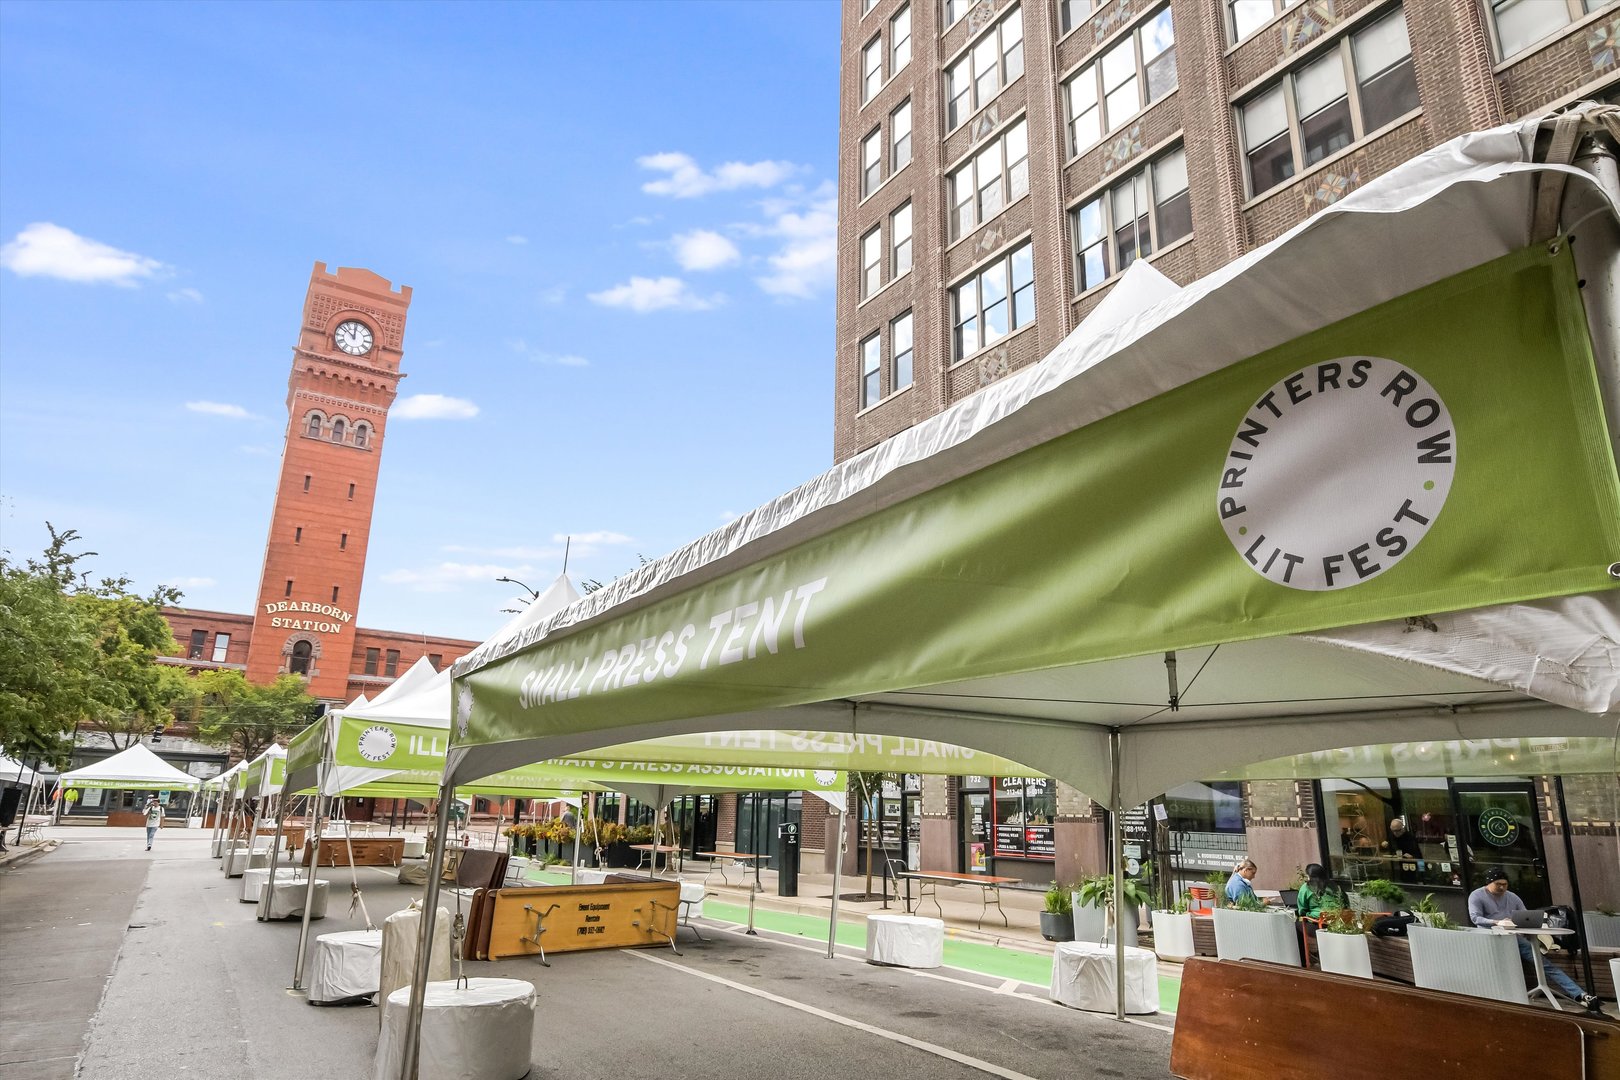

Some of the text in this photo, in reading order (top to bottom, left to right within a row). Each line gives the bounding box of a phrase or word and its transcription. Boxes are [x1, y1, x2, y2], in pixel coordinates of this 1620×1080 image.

[1219, 359, 1452, 520] PRINTERS ROW
[1244, 498, 1430, 587] LIT FEST
[265, 601, 353, 623] DEARBORN
[271, 617, 342, 634] STATION
[519, 656, 590, 710] SMALL
[587, 623, 696, 696] PRESS
[700, 576, 828, 671] TENT
[358, 725, 389, 747] PRINTERS
[360, 749, 391, 761] LIT FEST
[823, 777, 836, 786] FEST
[1002, 777, 1047, 788] CLEANERS
